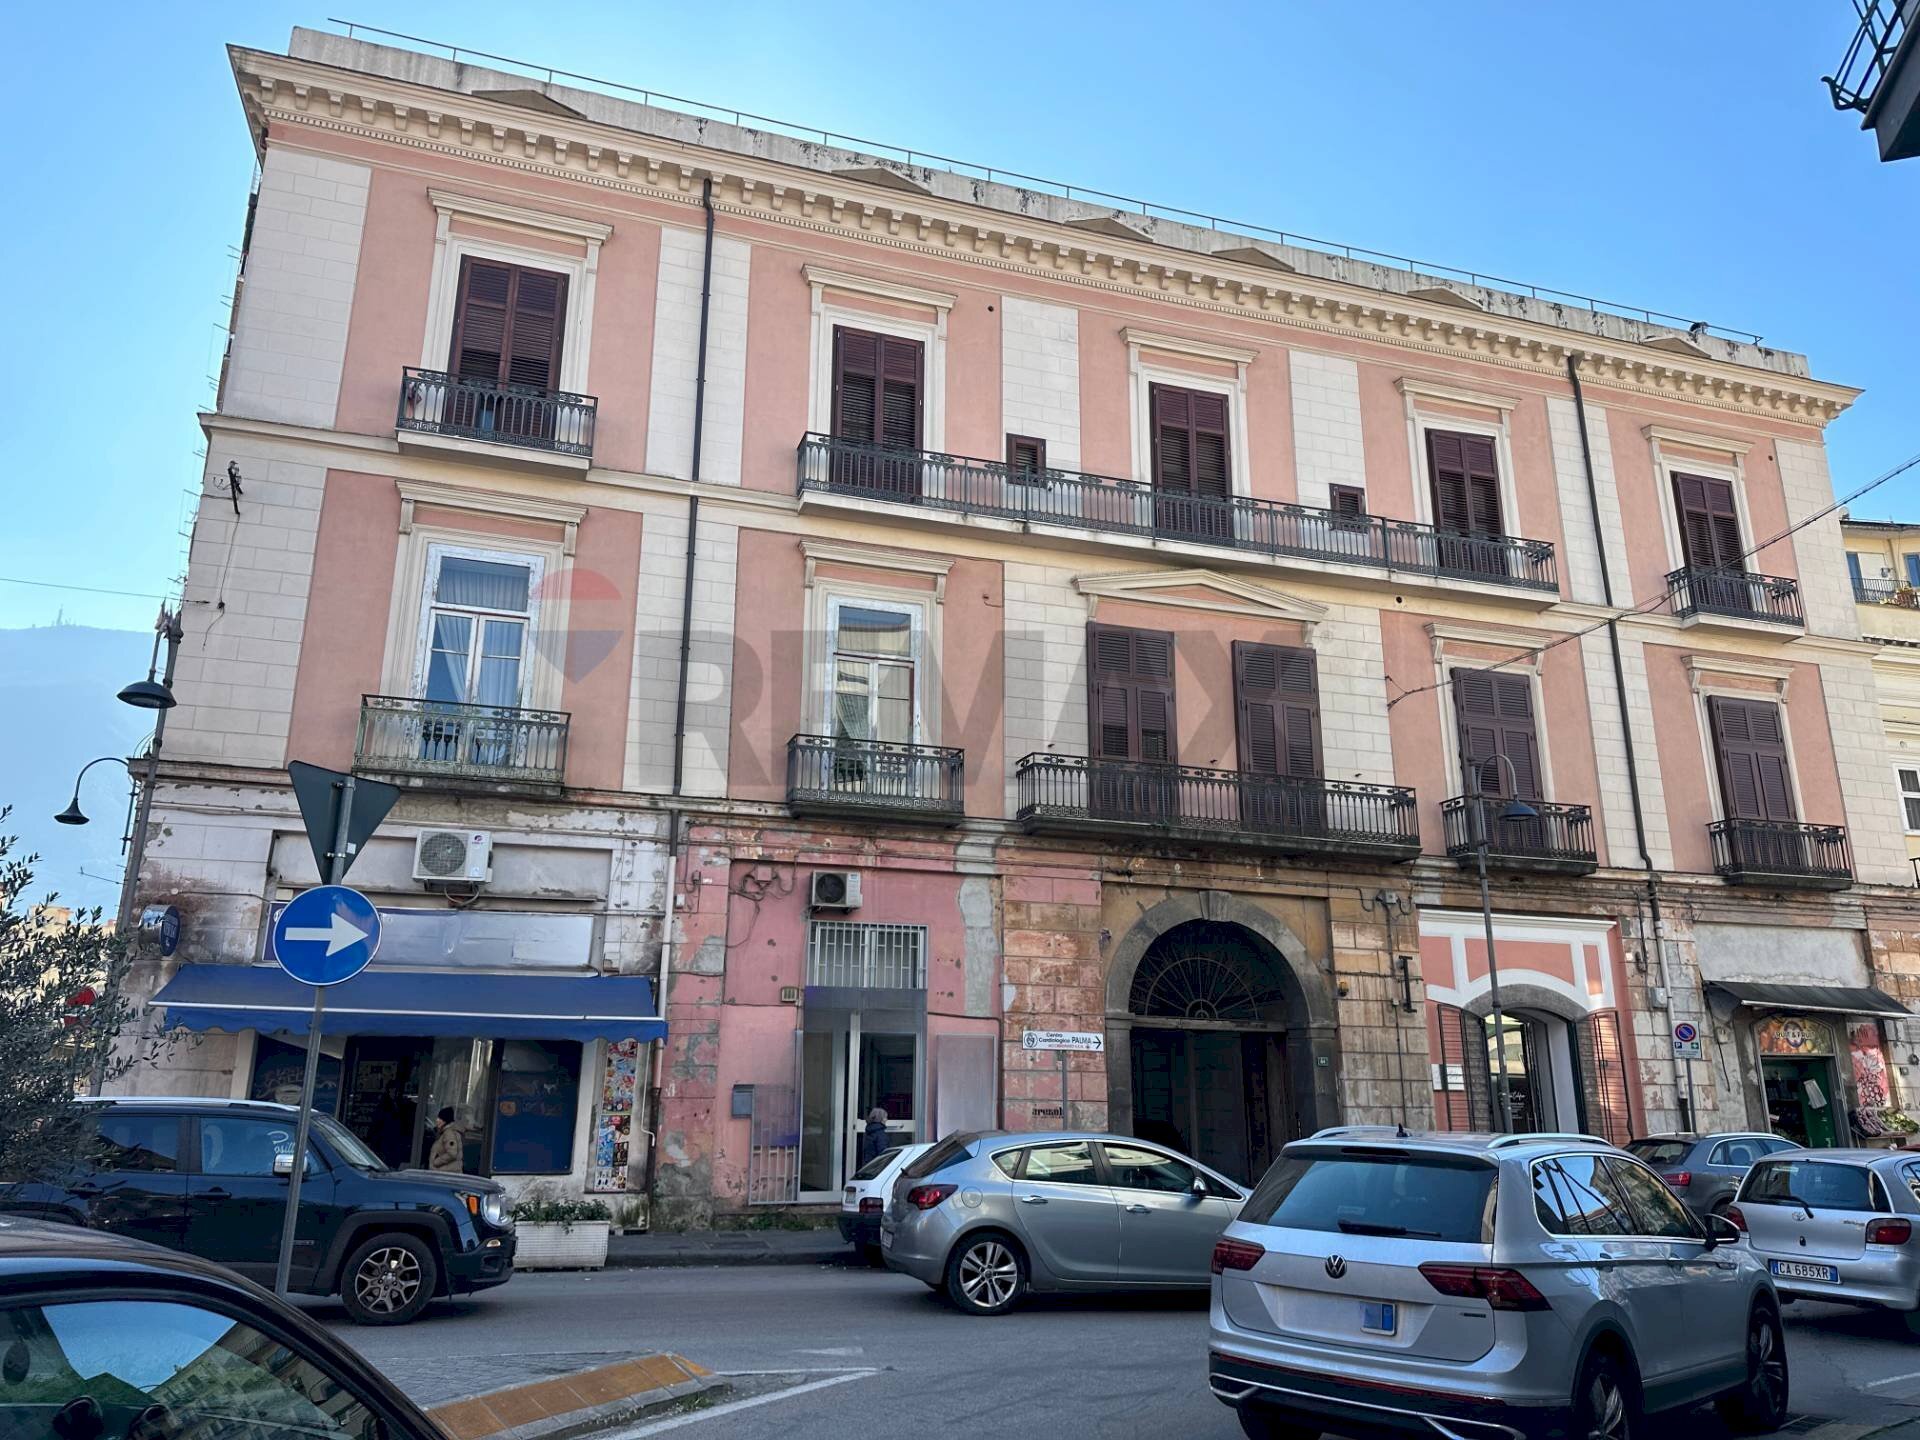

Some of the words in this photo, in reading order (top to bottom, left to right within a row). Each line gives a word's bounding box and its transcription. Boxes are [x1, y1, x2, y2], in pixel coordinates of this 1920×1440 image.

[1071, 1036, 1091, 1044] PALMA
[1779, 1262, 1792, 1275] CA
[1794, 1264, 1829, 1280] 685XR
